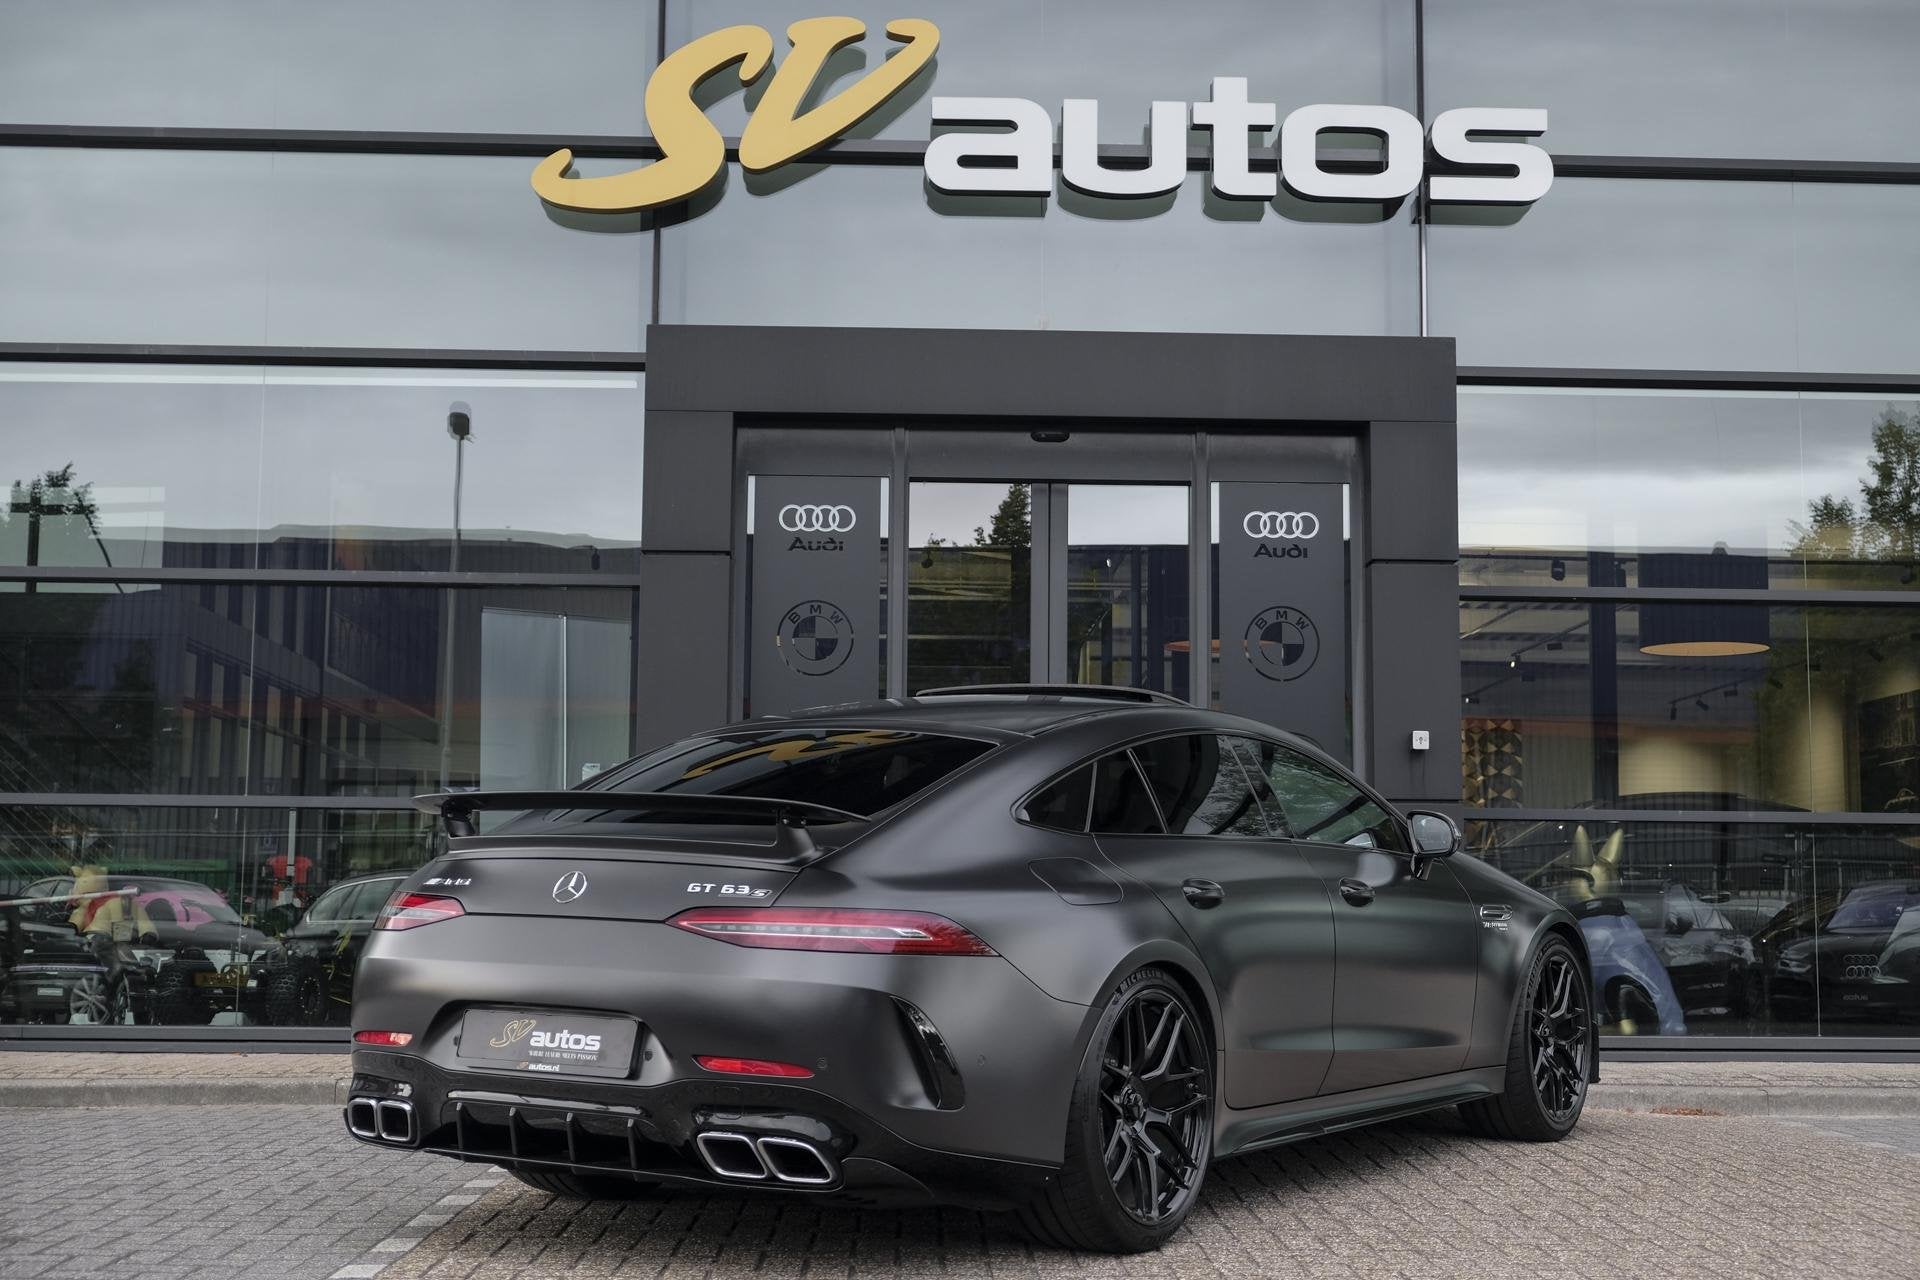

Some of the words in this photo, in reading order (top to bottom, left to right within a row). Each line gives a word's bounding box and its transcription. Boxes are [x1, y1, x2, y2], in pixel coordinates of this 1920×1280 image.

[922, 75, 1554, 205] autos
[787, 536, 845, 552] Audi
[1253, 543, 1309, 559] Audi
[787, 604, 844, 626] BMW
[1254, 610, 1310, 632] BMW
[686, 882, 717, 893] GT
[1120, 967, 1162, 993] MICHELIN
[529, 1029, 602, 1052] autos
[528, 1063, 560, 1072] autos.nl
